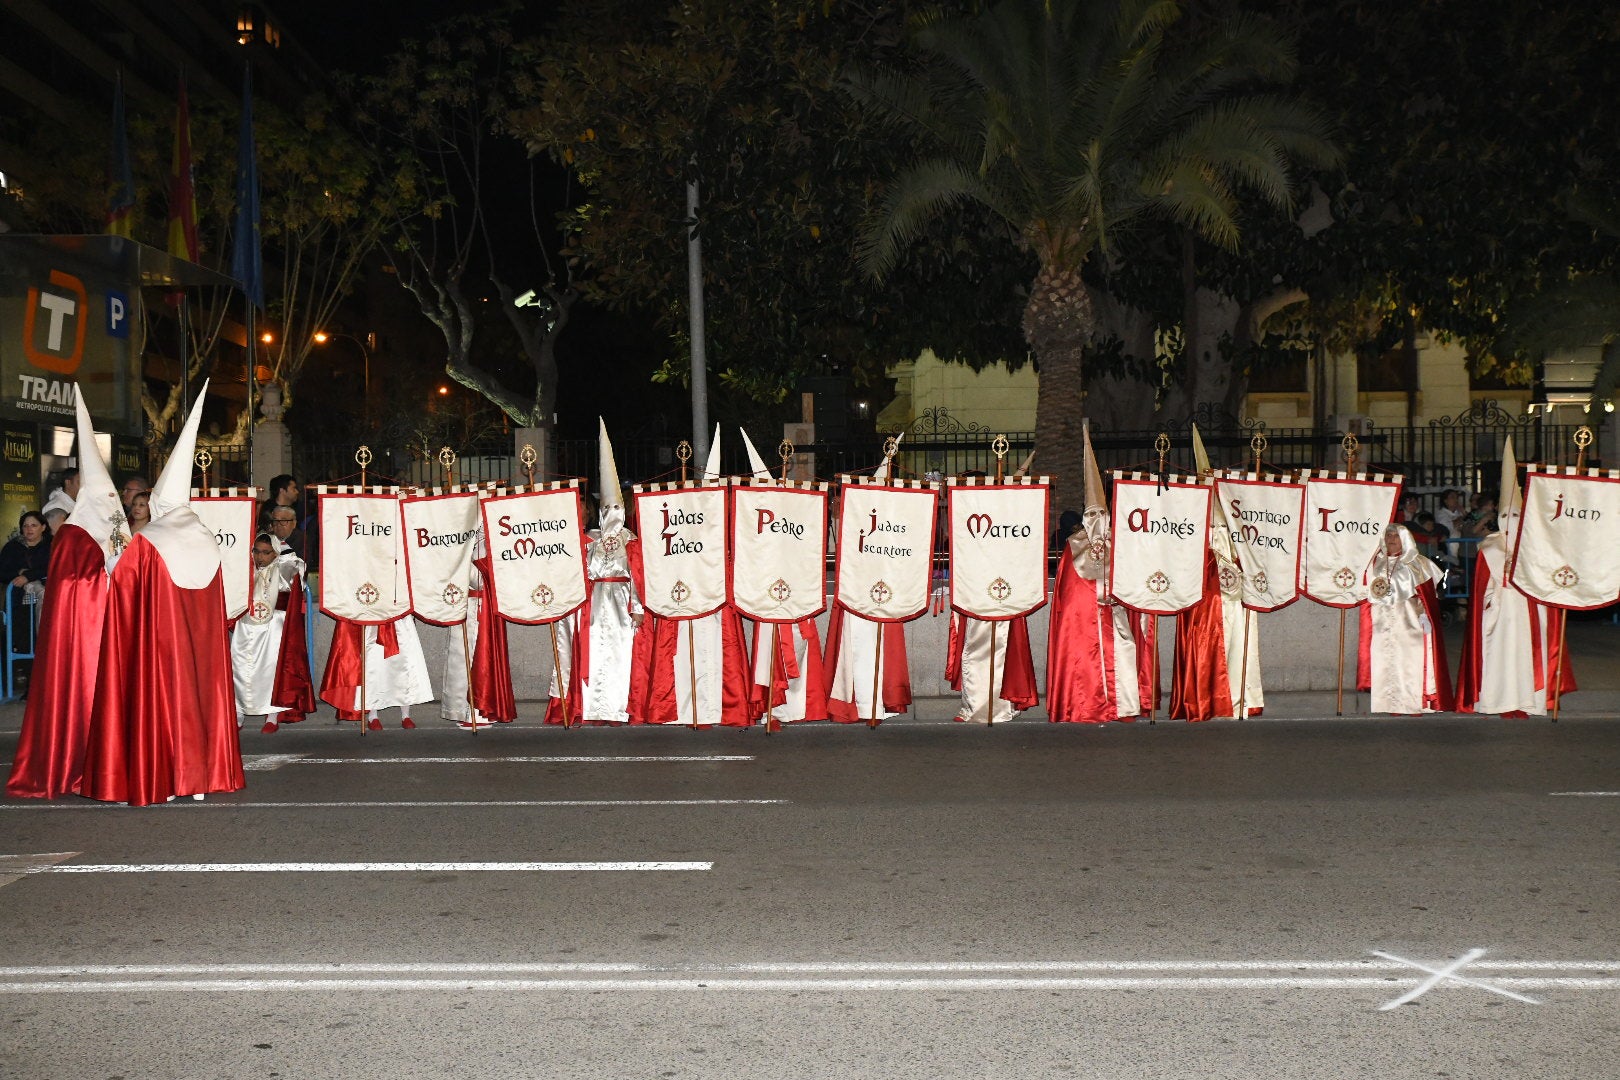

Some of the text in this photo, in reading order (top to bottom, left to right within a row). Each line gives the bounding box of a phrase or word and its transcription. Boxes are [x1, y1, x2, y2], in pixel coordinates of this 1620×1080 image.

[41, 291, 76, 351] T
[111, 297, 125, 330] P
[18, 374, 77, 407] TRAM
[498, 515, 567, 537] Santiago
[755, 508, 804, 540] Pedro
[966, 513, 1031, 539] Mateo
[1127, 507, 1195, 540] Andrés
[1230, 499, 1291, 526] Santiago
[1318, 507, 1380, 536] Tomás
[346, 514, 392, 541] Felipe
[1241, 524, 1290, 555] Menor
[513, 537, 574, 560] Mayor
[661, 530, 703, 557] Tadeo
